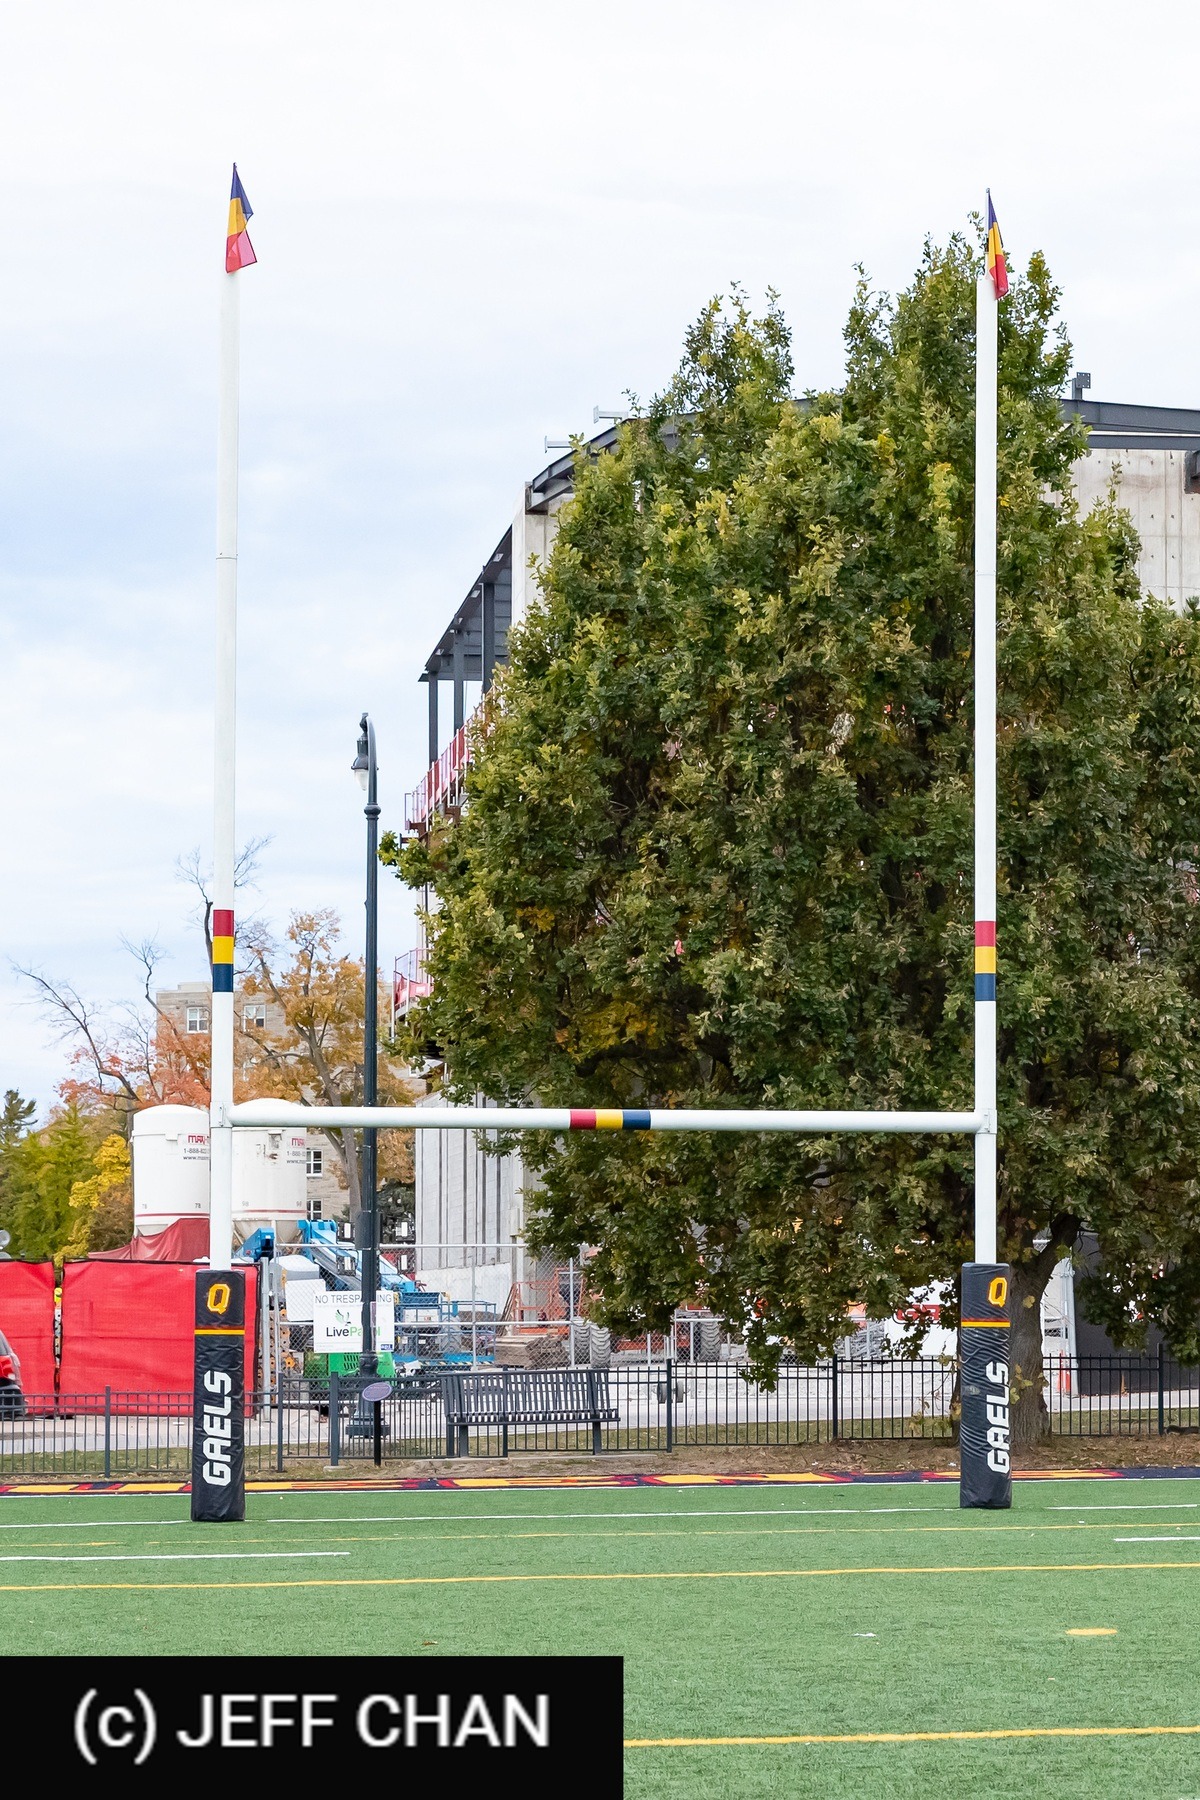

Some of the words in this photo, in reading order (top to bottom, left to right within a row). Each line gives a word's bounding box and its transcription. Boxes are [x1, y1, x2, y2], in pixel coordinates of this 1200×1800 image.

[207, 1283, 231, 1314] Q
[315, 1295, 328, 1304] NO
[331, 1294, 392, 1304] TRESPING
[988, 1277, 1008, 1307] Q
[326, 1327, 381, 1337] LivePal
[203, 1370, 231, 1486] GAELS
[986, 1360, 1010, 1474] GAELS
